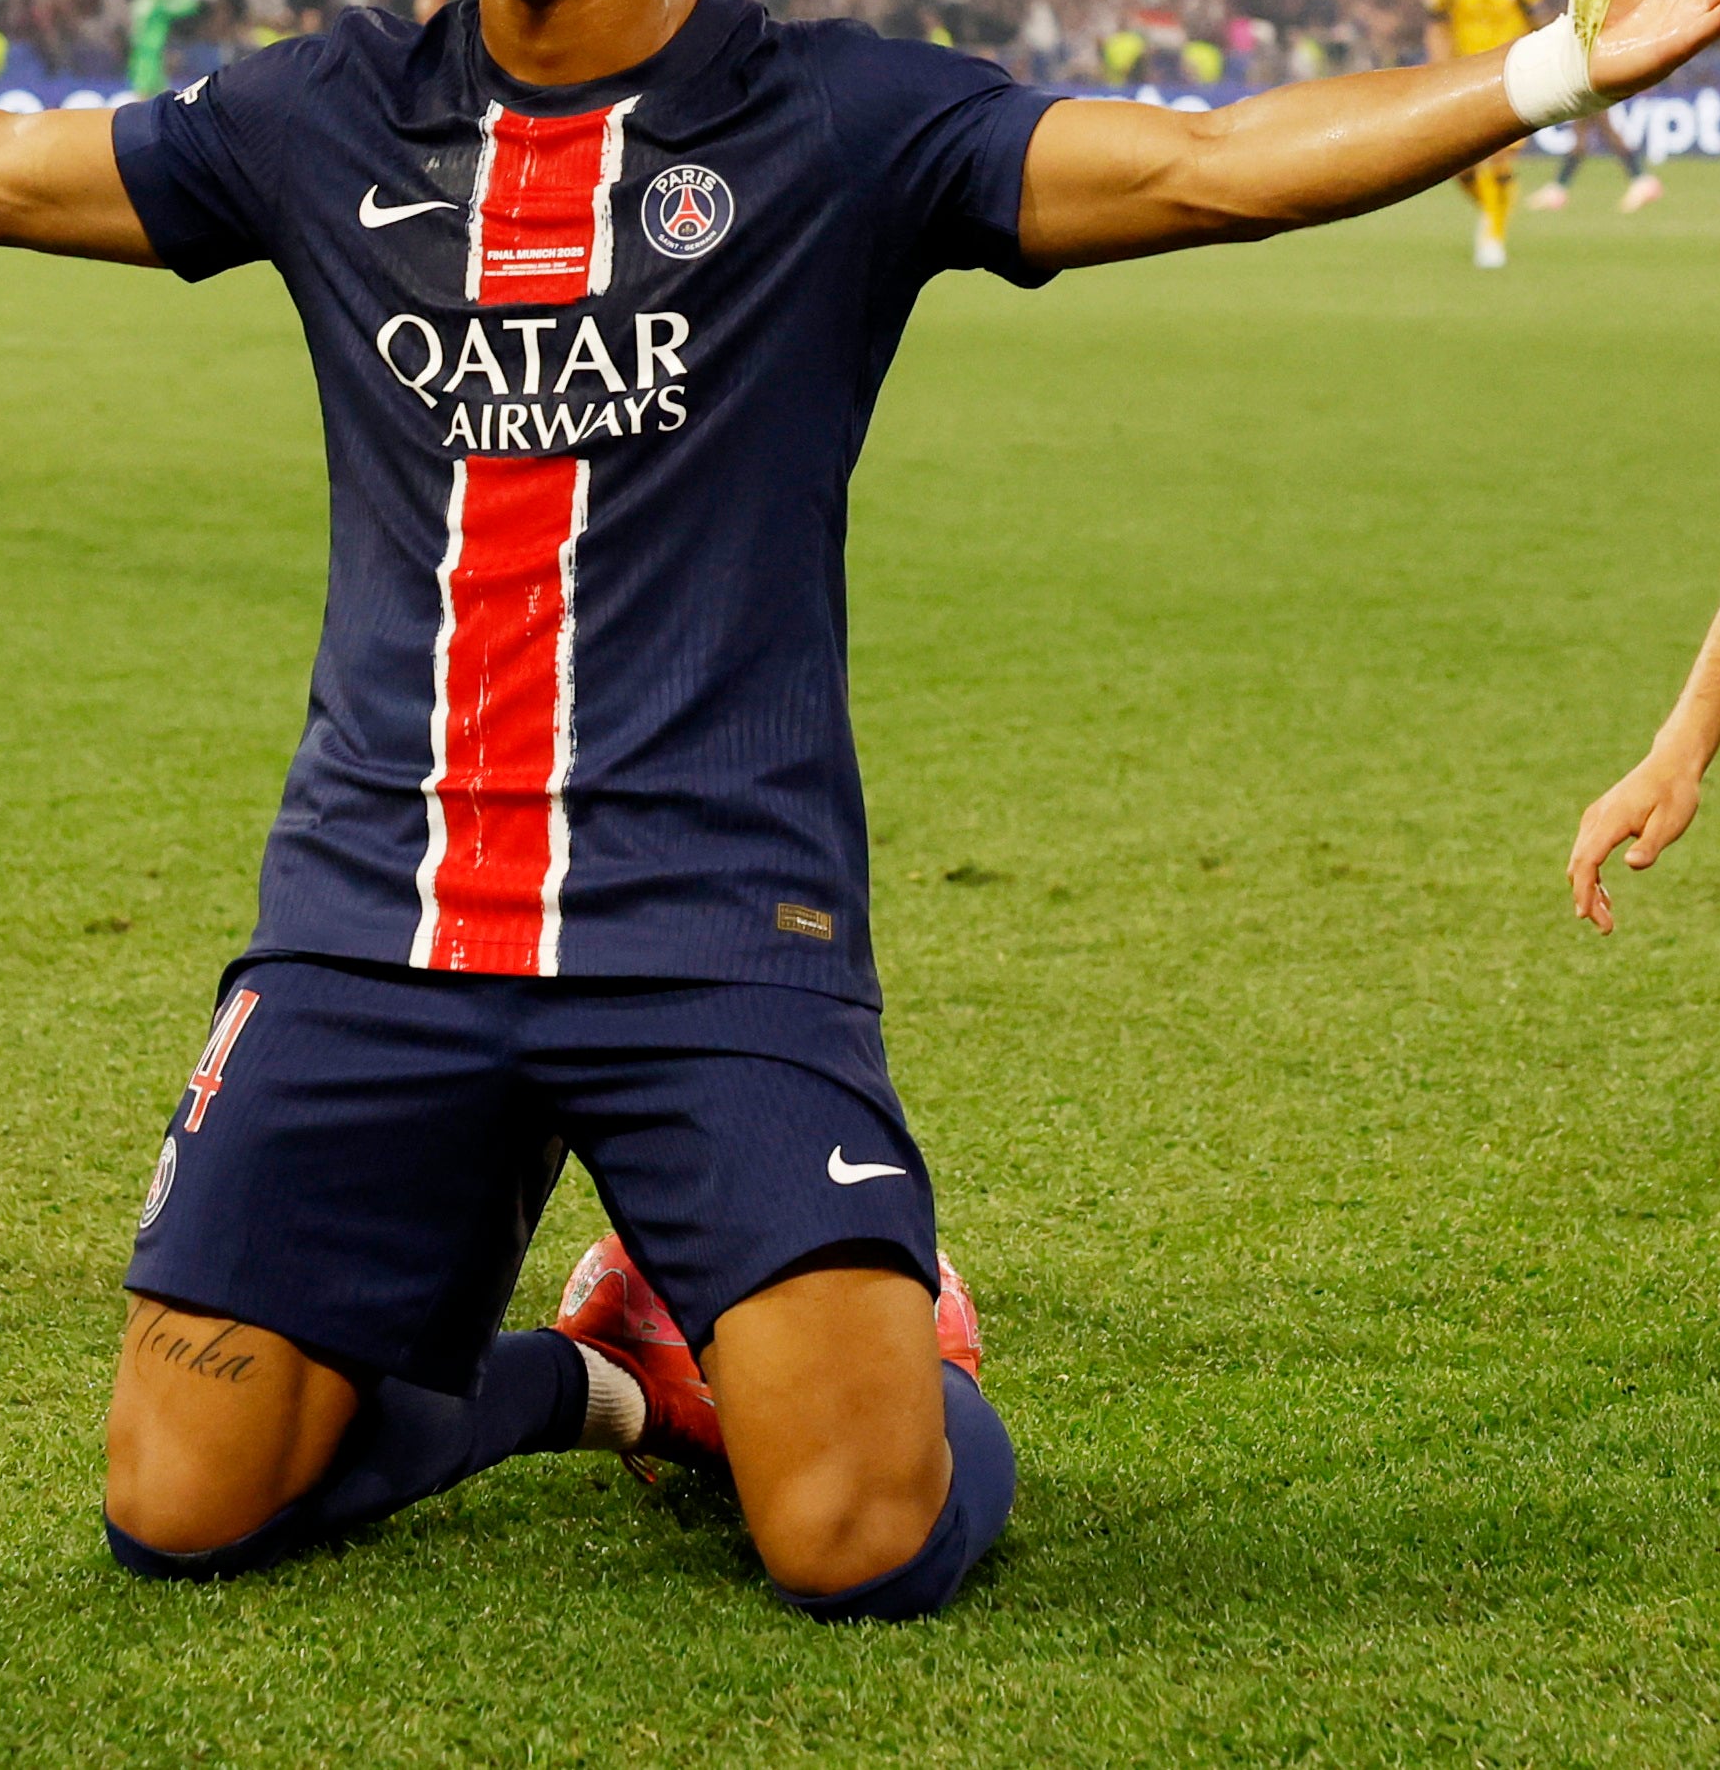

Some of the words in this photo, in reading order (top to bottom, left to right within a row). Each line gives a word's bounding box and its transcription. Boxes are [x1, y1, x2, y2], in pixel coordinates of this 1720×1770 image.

[655, 169, 717, 195] PARIS
[487, 249, 516, 261] FINAL
[517, 248, 556, 260] MUNICH
[557, 246, 585, 258] 2025
[376, 311, 690, 409] QATAR
[442, 383, 688, 451] AIRWAYS
[184, 988, 261, 1133] 4
